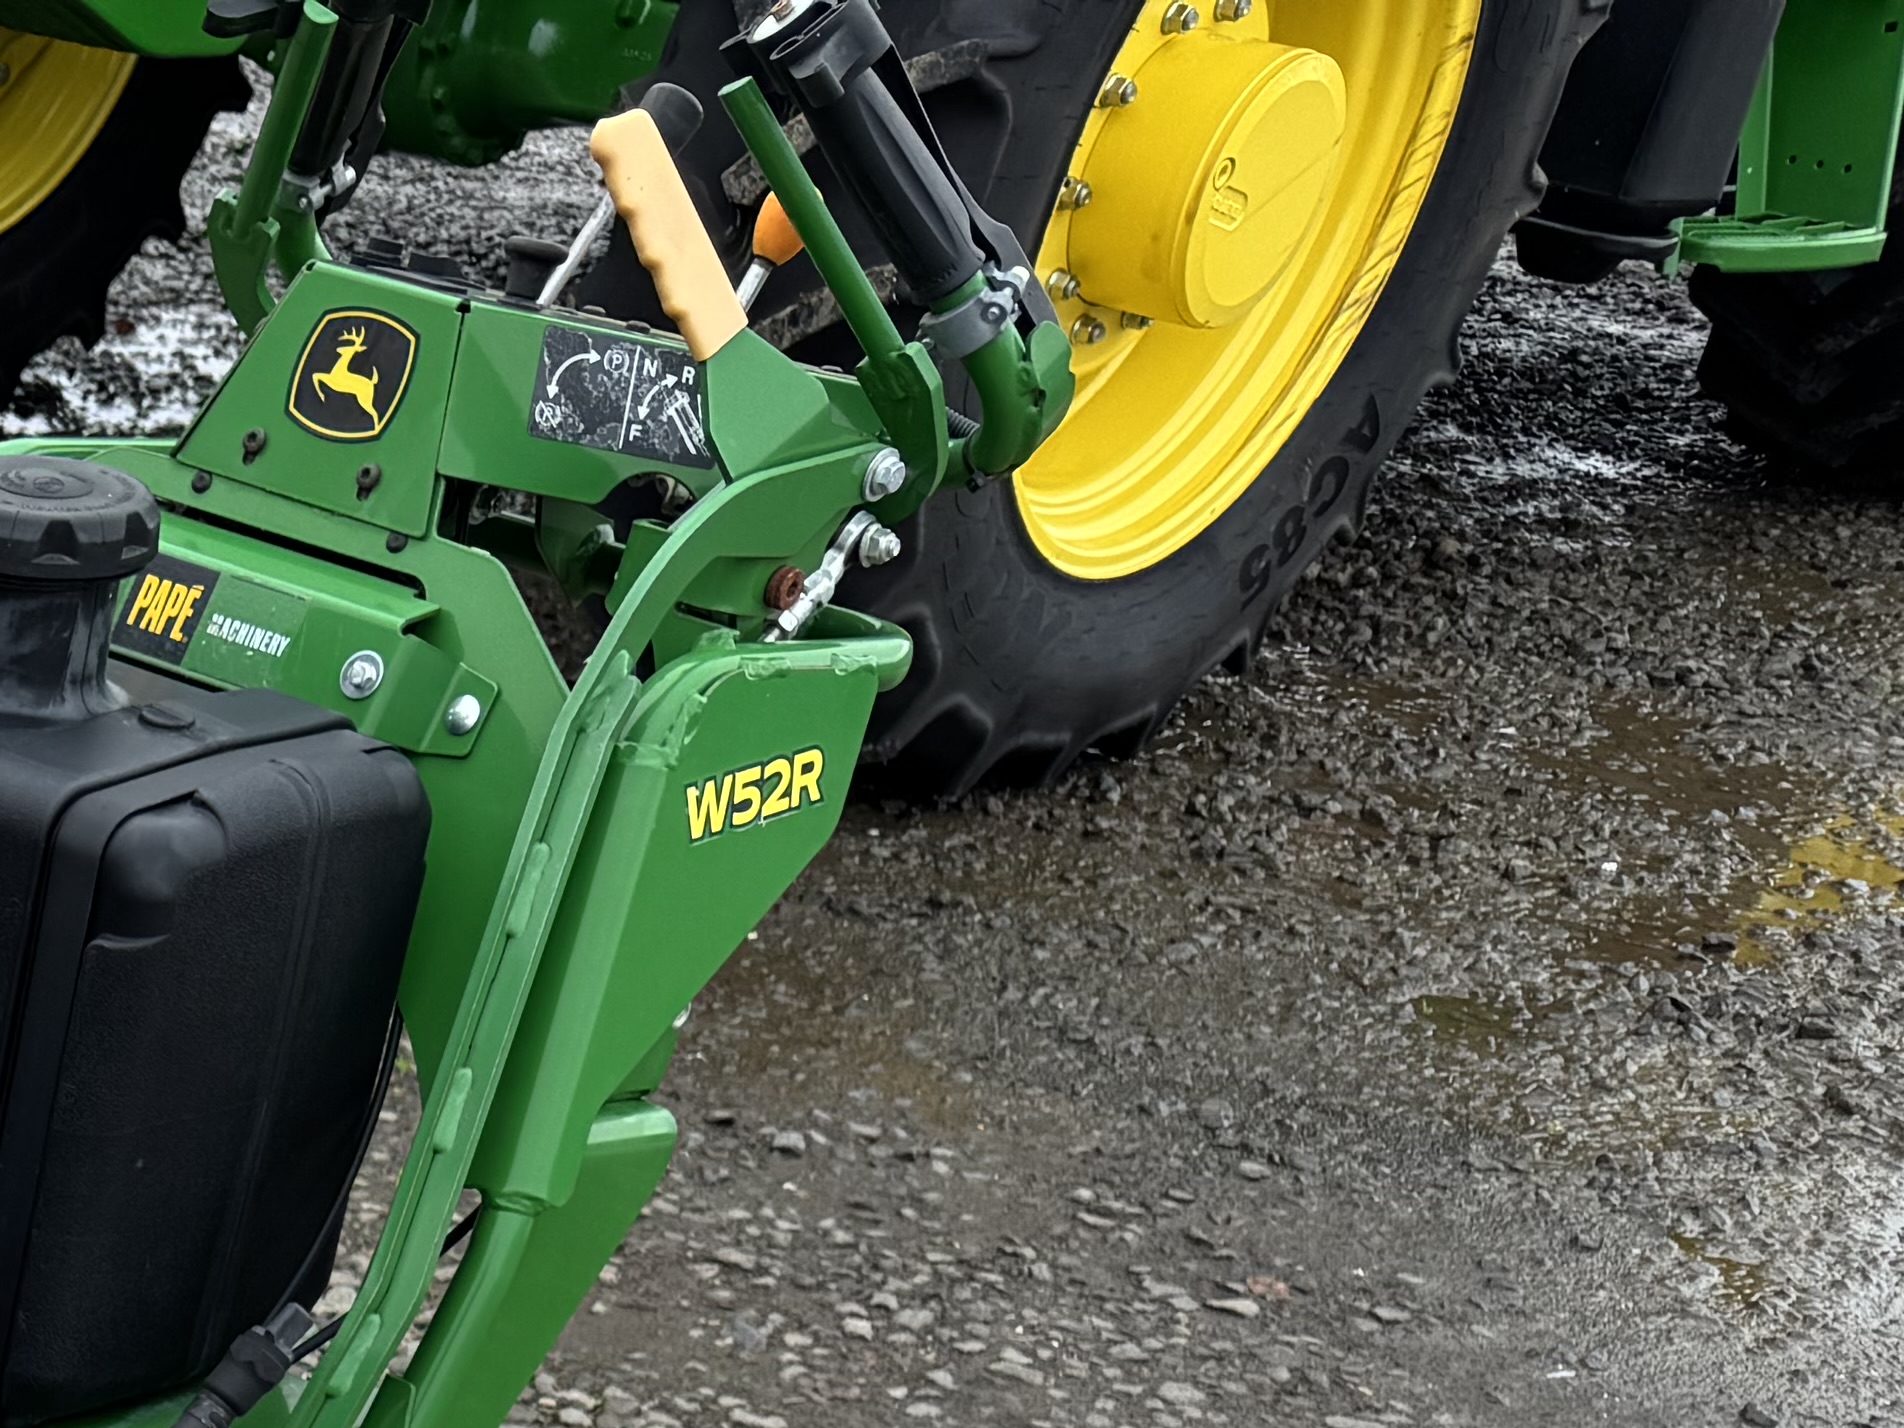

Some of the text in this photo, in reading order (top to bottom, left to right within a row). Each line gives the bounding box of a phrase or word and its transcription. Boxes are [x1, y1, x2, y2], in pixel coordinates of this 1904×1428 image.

[643, 358, 658, 377] N
[682, 366, 696, 385] R
[629, 424, 642, 441] F
[206, 613, 291, 658] MACHINERY
[685, 747, 824, 840] W52R
